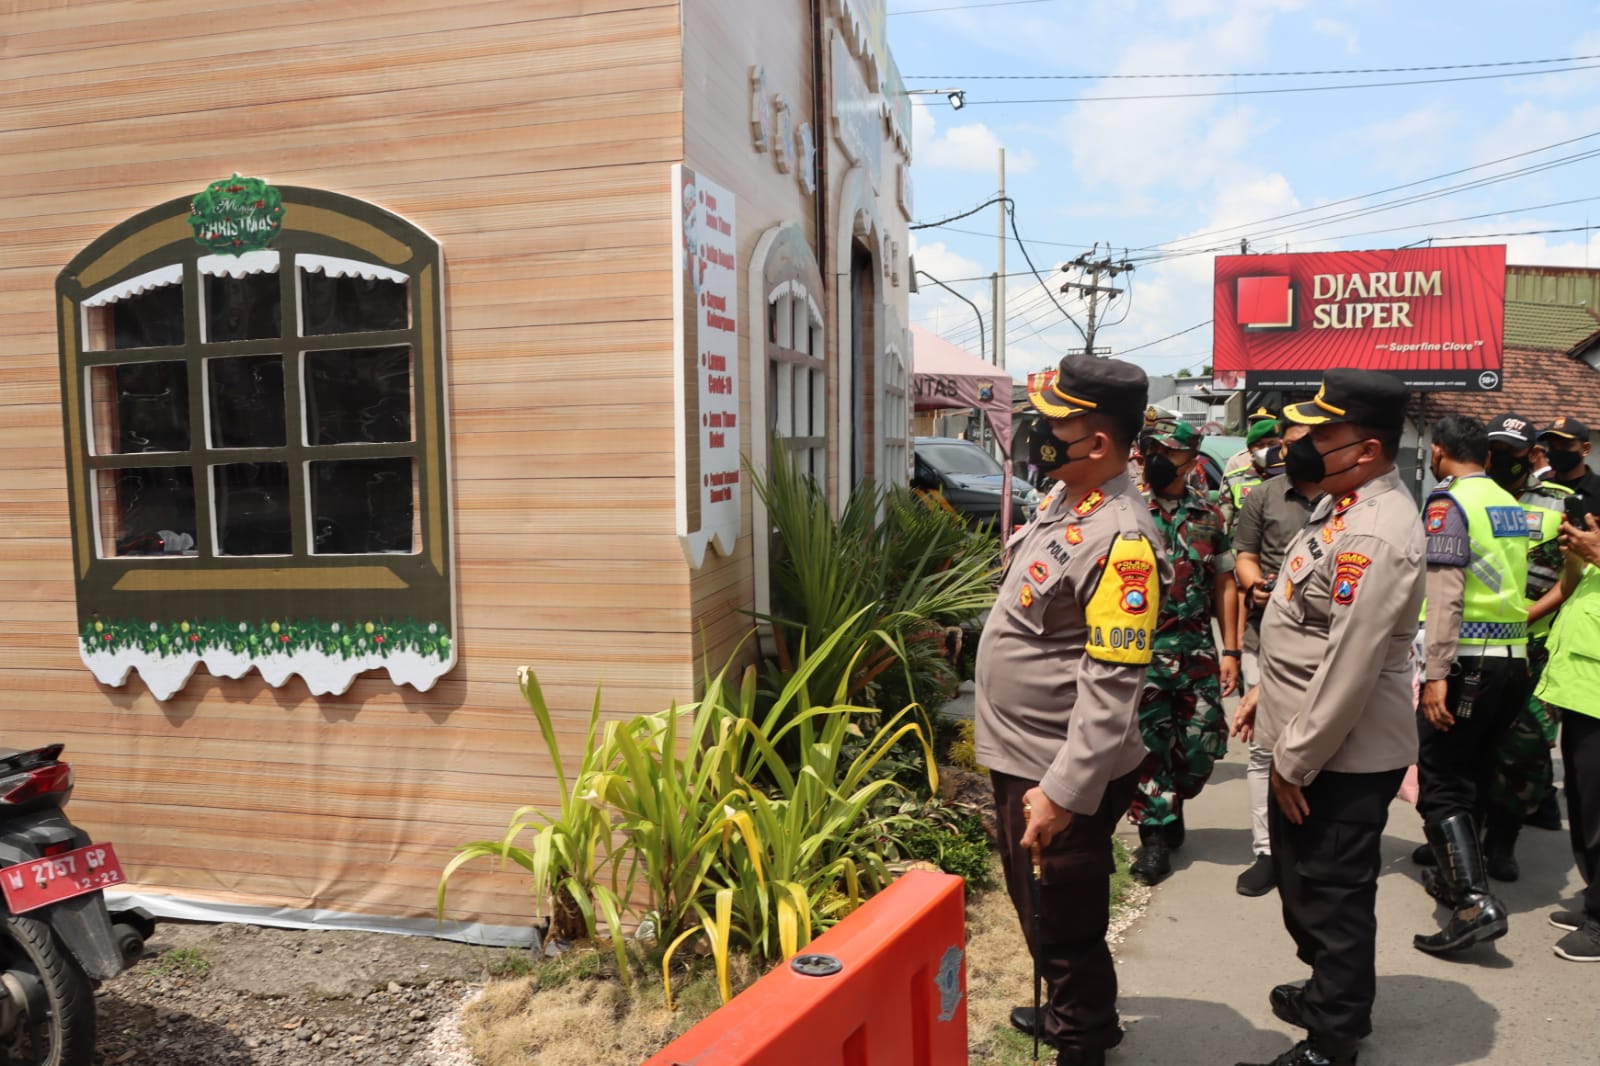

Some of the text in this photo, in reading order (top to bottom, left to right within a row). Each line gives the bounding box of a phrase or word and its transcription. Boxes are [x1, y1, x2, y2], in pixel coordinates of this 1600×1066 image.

[214, 199, 256, 217] Merry
[1313, 270, 1443, 301] DJARUM
[1313, 302, 1414, 329] SUPER
[1389, 342, 1440, 352] Superfine
[1046, 540, 1070, 566] POLRI
[1110, 627, 1146, 650] OPS
[8, 848, 106, 890] W 2757 GP
